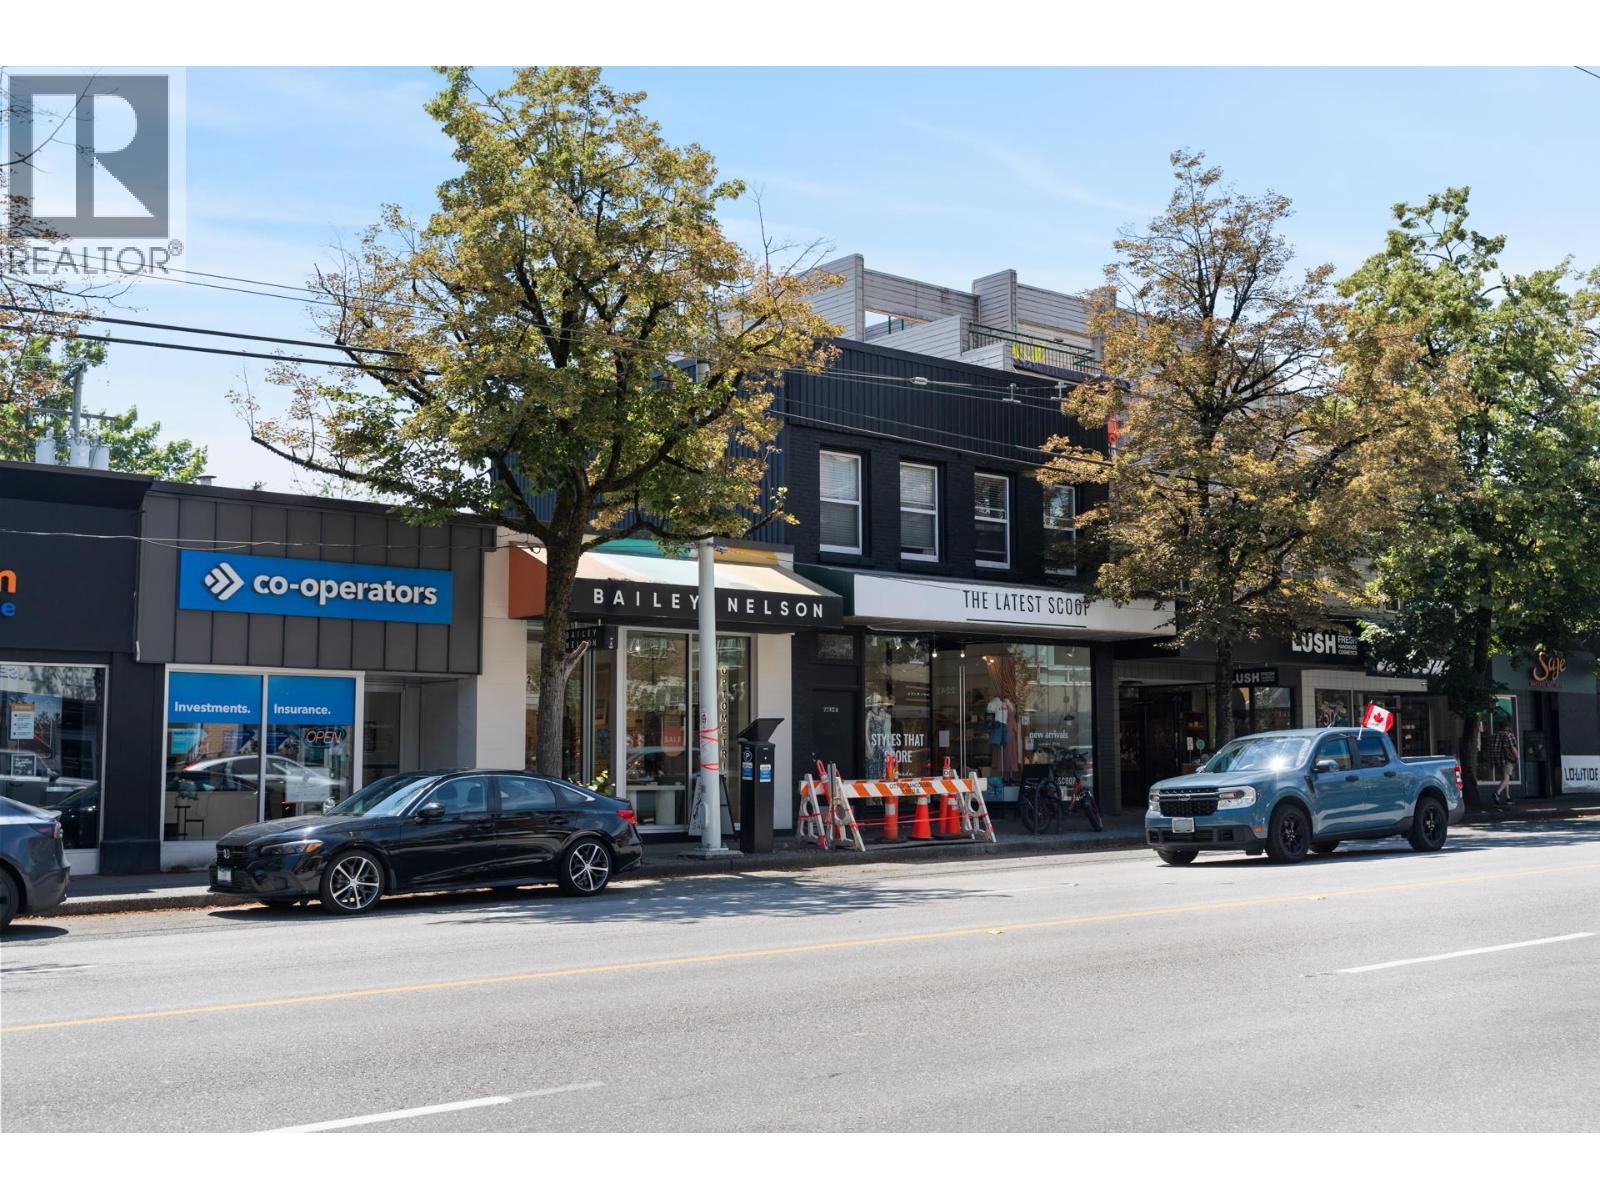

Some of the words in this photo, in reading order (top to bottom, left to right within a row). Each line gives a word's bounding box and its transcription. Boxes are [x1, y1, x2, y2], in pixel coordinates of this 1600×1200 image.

[253, 573, 438, 606] co-operators
[593, 588, 699, 610] BAILEY
[728, 597, 823, 618] NELSON
[963, 590, 988, 610] THE
[995, 592, 1041, 613] LATEST
[1292, 632, 1337, 654] LUSH
[1533, 652, 1566, 681] Saje
[174, 701, 251, 715] Investments.
[273, 704, 331, 715] Insurance.
[306, 731, 342, 744] OPEN
[871, 733, 902, 746] STYLES
[904, 734, 924, 746] THAT
